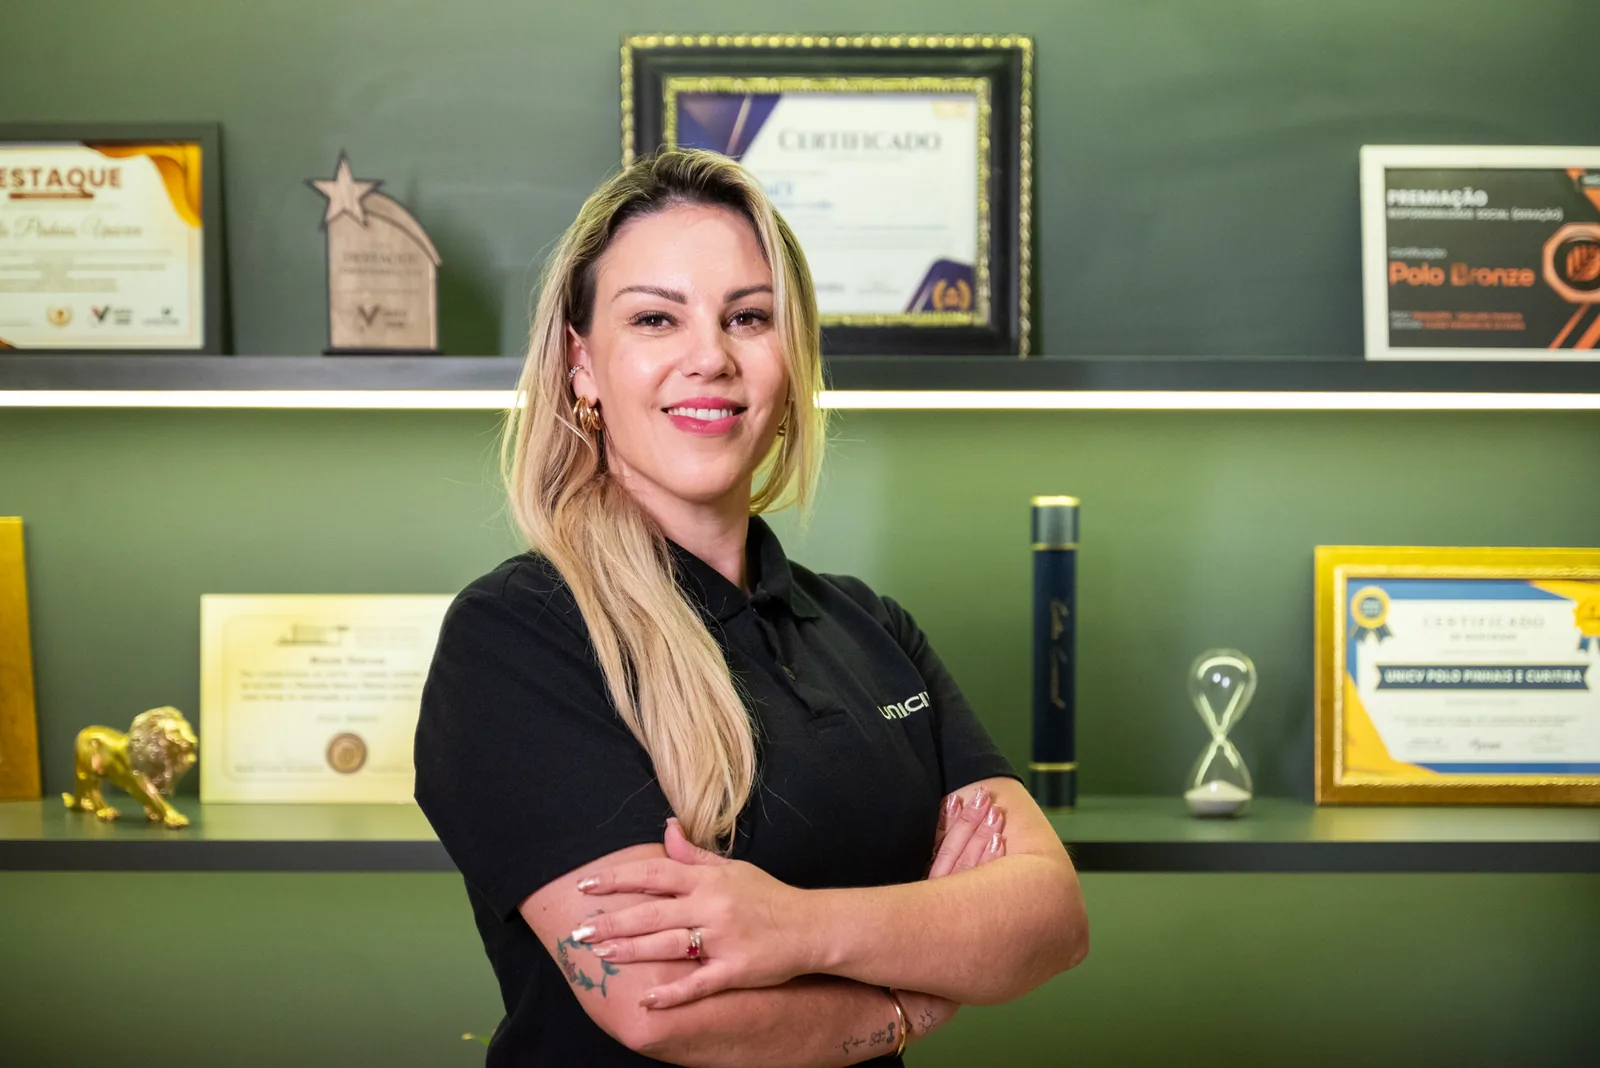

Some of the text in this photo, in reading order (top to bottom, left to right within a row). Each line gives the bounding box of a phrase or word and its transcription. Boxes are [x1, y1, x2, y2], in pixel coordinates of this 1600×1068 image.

[778, 128, 942, 152] CERTIFICADO
[1387, 187, 1489, 209] PREMIAÇÃO
[1389, 262, 1536, 287] Polo Bronze
[1427, 669, 1462, 683] POLO
[1463, 669, 1514, 683] PINHAIS
[1515, 669, 1524, 683] E
[1525, 669, 1583, 683] CURITIBA
